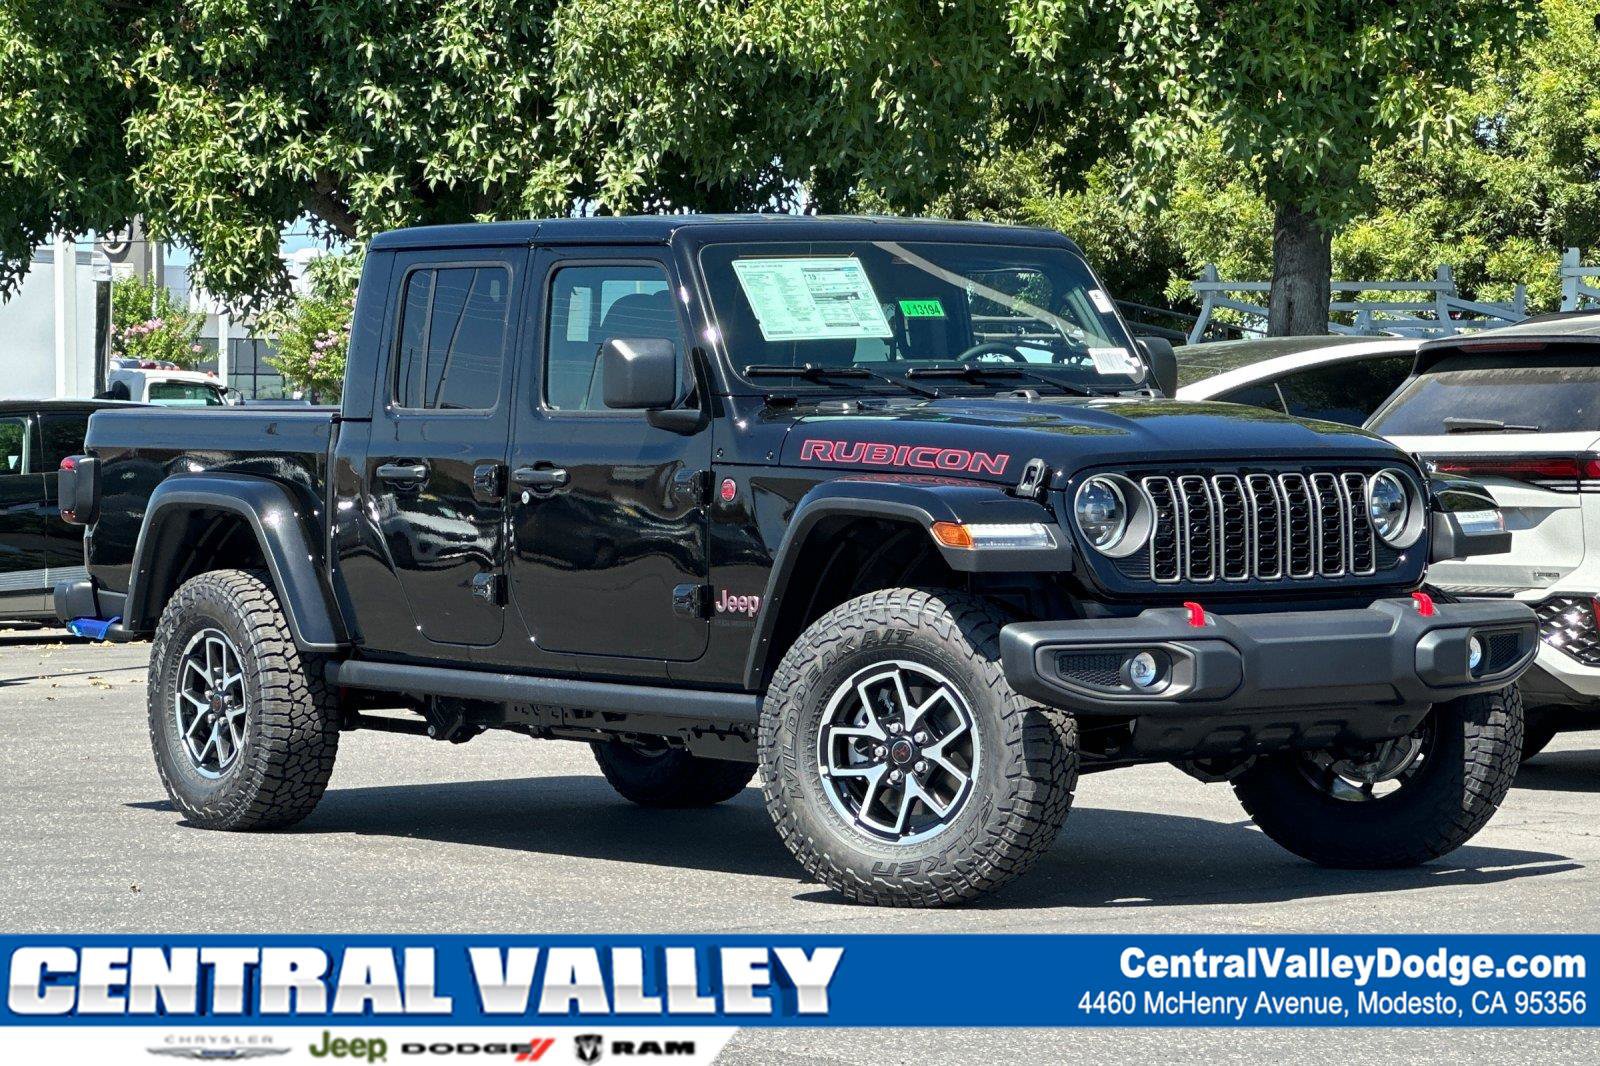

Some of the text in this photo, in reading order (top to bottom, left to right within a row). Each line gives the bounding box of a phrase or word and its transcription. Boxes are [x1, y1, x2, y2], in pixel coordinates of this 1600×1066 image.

[913, 304, 941, 315] 13194
[800, 439, 1010, 475] RUBICON
[715, 589, 760, 618] Jeep
[783, 628, 915, 799] WILDPEAK A/T
[869, 793, 995, 877] FALKEN
